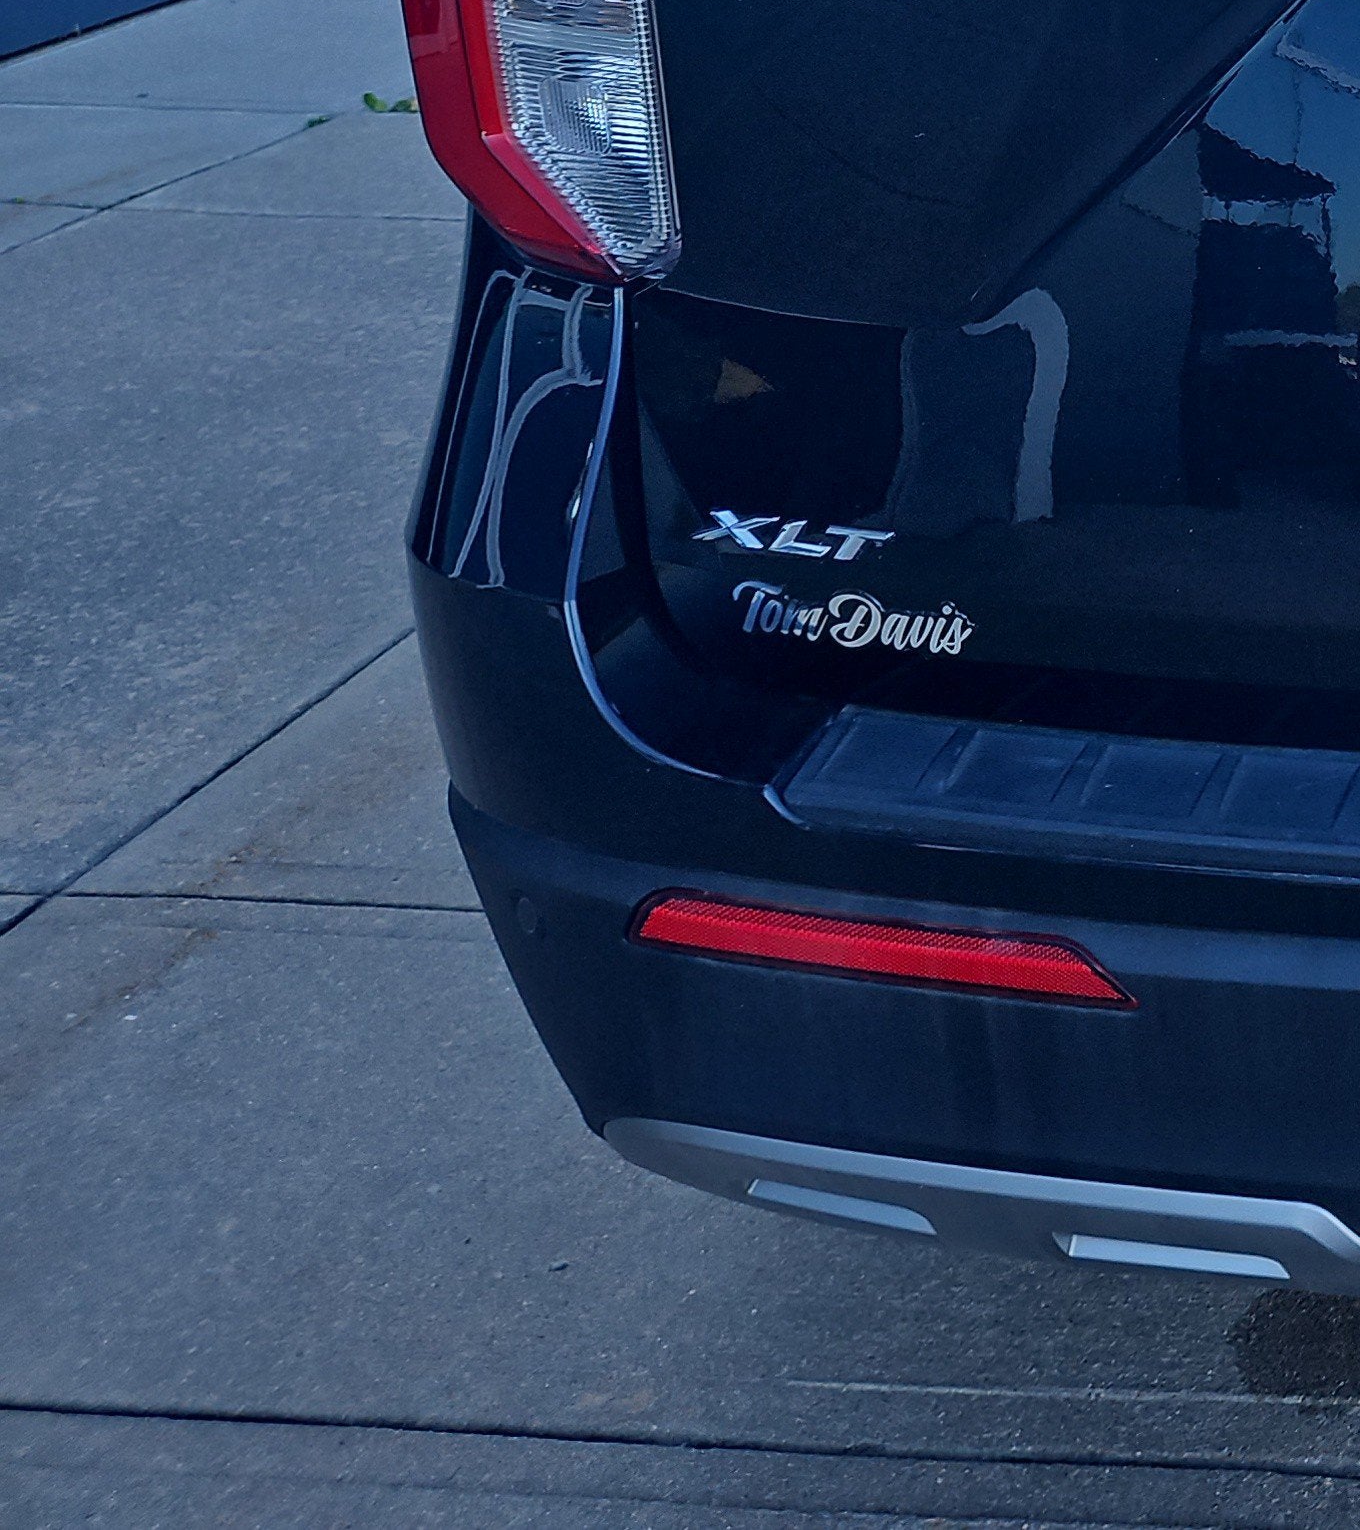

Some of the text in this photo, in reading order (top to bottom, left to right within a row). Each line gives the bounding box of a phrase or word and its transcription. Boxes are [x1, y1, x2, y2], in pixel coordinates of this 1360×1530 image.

[691, 509, 897, 561] XLT
[732, 579, 976, 655] Tom Davis
